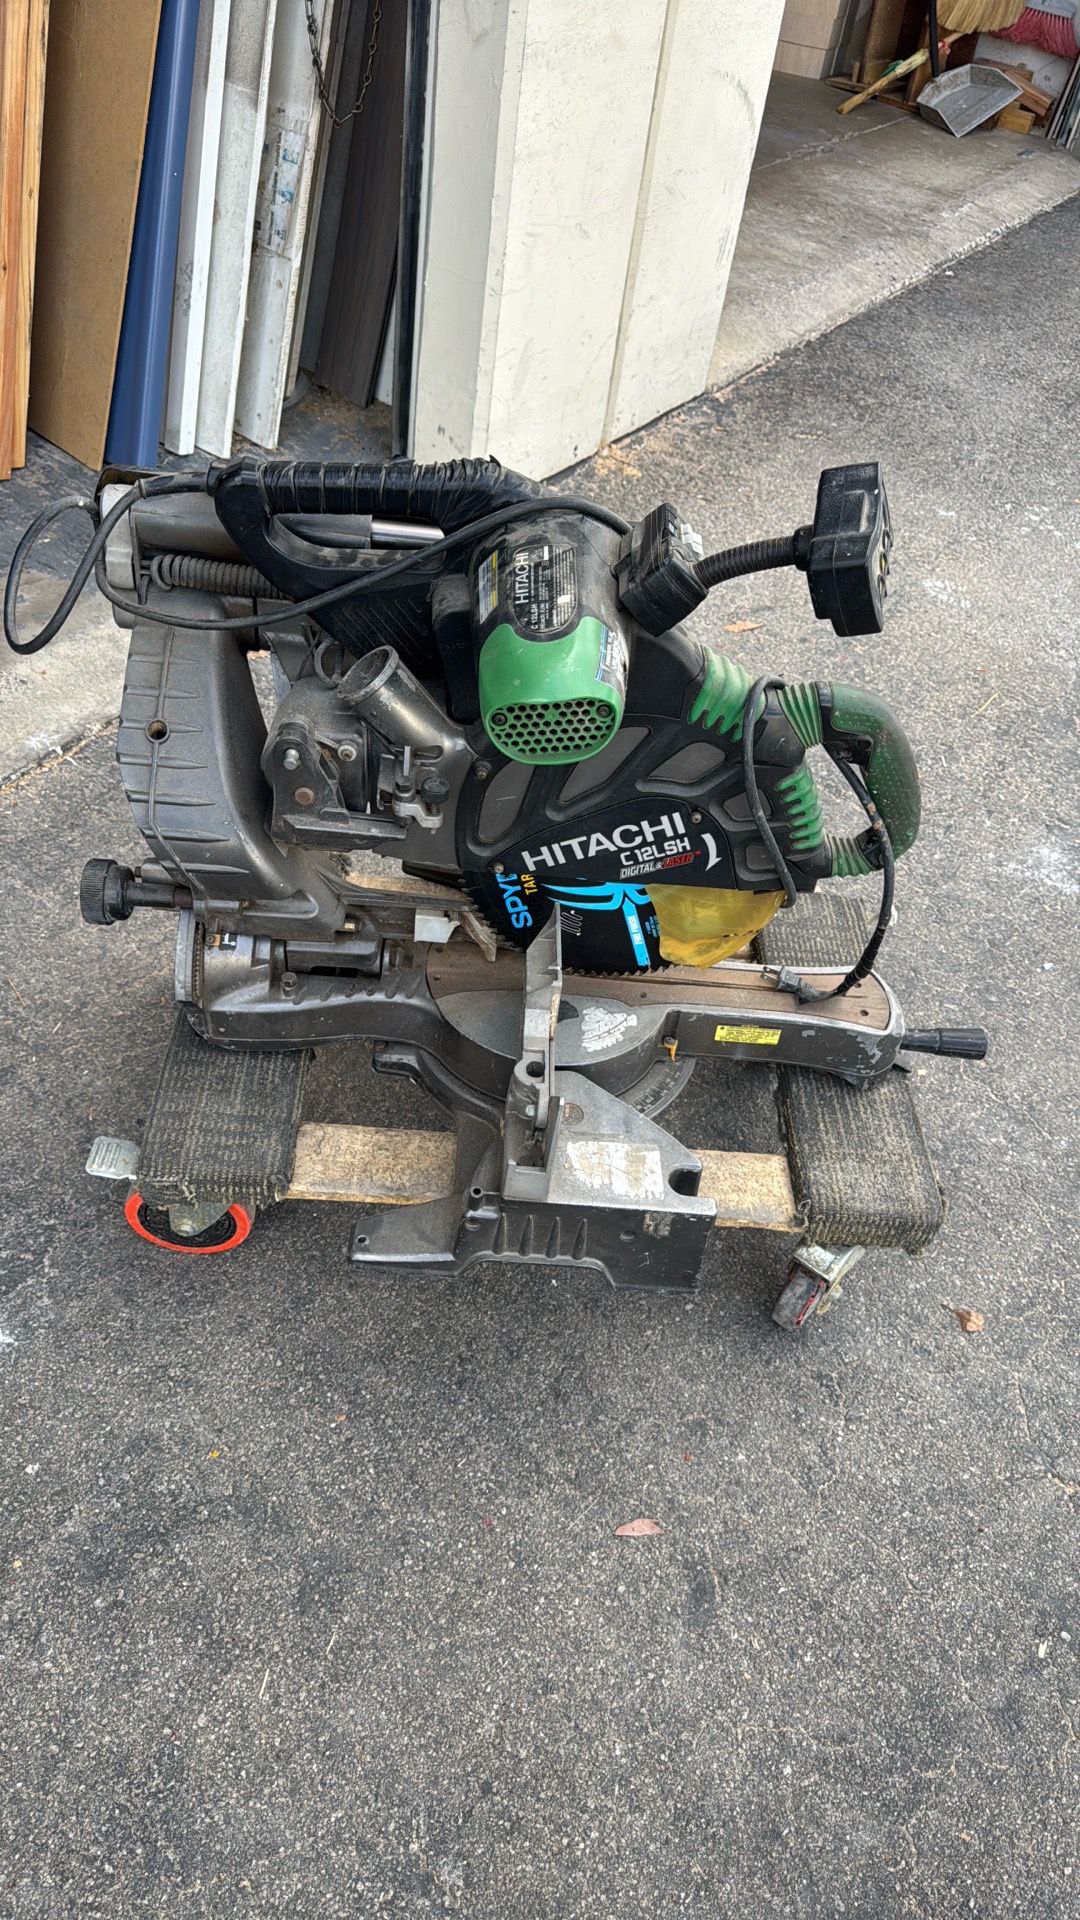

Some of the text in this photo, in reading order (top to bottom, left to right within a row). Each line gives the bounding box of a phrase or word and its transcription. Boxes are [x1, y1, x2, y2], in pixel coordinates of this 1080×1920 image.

[515, 552, 529, 604] HITACHI
[530, 603, 538, 624] 12LSH
[521, 812, 686, 872] HITACHI
[620, 837, 691, 866] C 12LSH
[619, 861, 656, 880] DIGITAL
